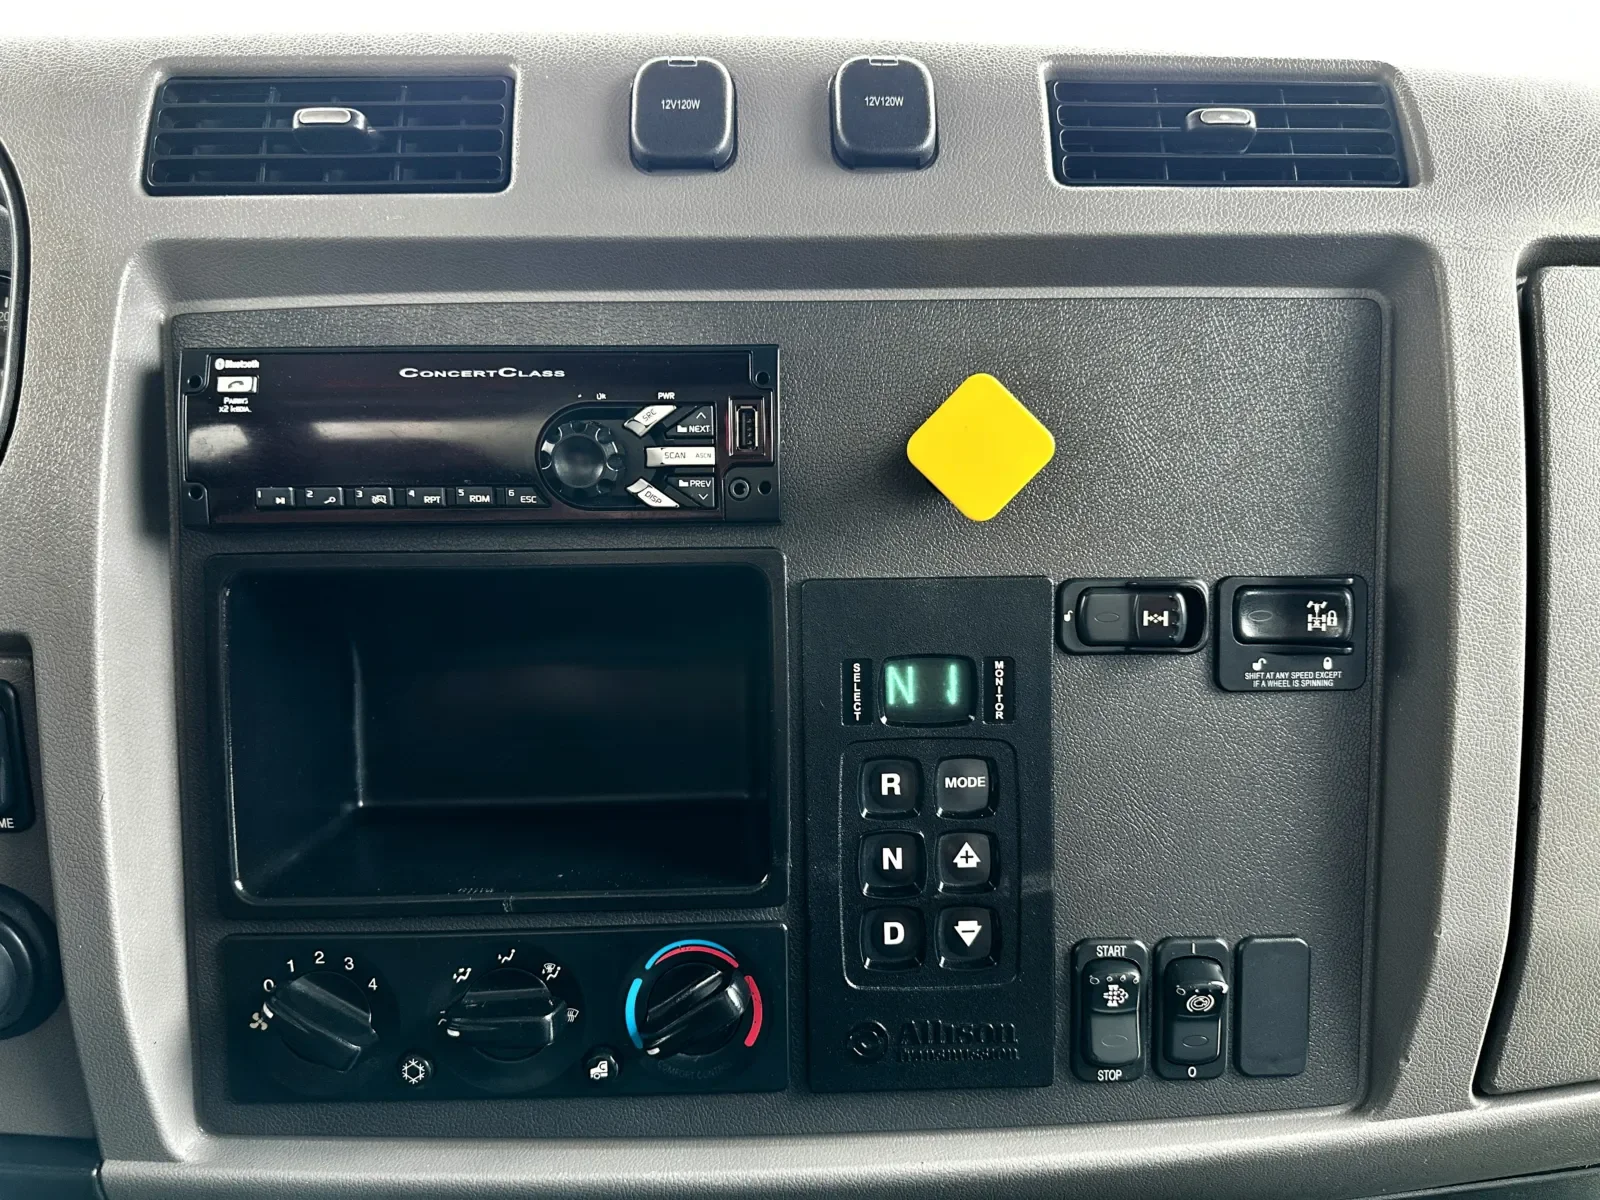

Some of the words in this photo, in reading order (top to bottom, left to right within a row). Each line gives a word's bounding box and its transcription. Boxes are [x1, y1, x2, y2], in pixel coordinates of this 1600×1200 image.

[661, 99, 701, 110] 12V120W
[864, 96, 904, 107] 12V120W
[657, 391, 676, 400] PWR
[642, 408, 657, 422] SRC
[688, 425, 710, 433] NEXT
[664, 451, 687, 460] SCAN
[689, 479, 712, 488] PREV
[306, 490, 314, 498] 2
[356, 490, 363, 498] 3
[408, 489, 415, 497] 4
[458, 488, 465, 497] 5
[508, 489, 515, 497] 6
[644, 490, 662, 504] DISP
[423, 495, 441, 504] RPT
[469, 494, 491, 503] RDM
[520, 495, 537, 504] ESC
[1244, 671, 1265, 681] SHIFT
[1266, 671, 1275, 680] AT
[1275, 671, 1290, 680] ANY
[1290, 671, 1314, 680] SPEED
[1315, 671, 1342, 679] EXCEPT
[886, 665, 915, 705] N
[1253, 680, 1261, 688] IF
[1261, 680, 1267, 688] A
[1267, 679, 1291, 688] WHEEL
[1292, 679, 1299, 687] IS
[1300, 679, 1334, 687] SPINNING
[853, 662, 862, 721] SELECT
[994, 660, 1005, 720] MONITOR
[881, 773, 901, 796] R
[944, 776, 986, 789] MODE
[882, 847, 903, 870] N
[883, 921, 905, 945] D
[1096, 945, 1127, 957] START
[314, 950, 326, 964] 2
[286, 959, 295, 972] 1
[344, 956, 355, 970] 3
[368, 977, 378, 991] 4
[1097, 1069, 1123, 1082] STOP
